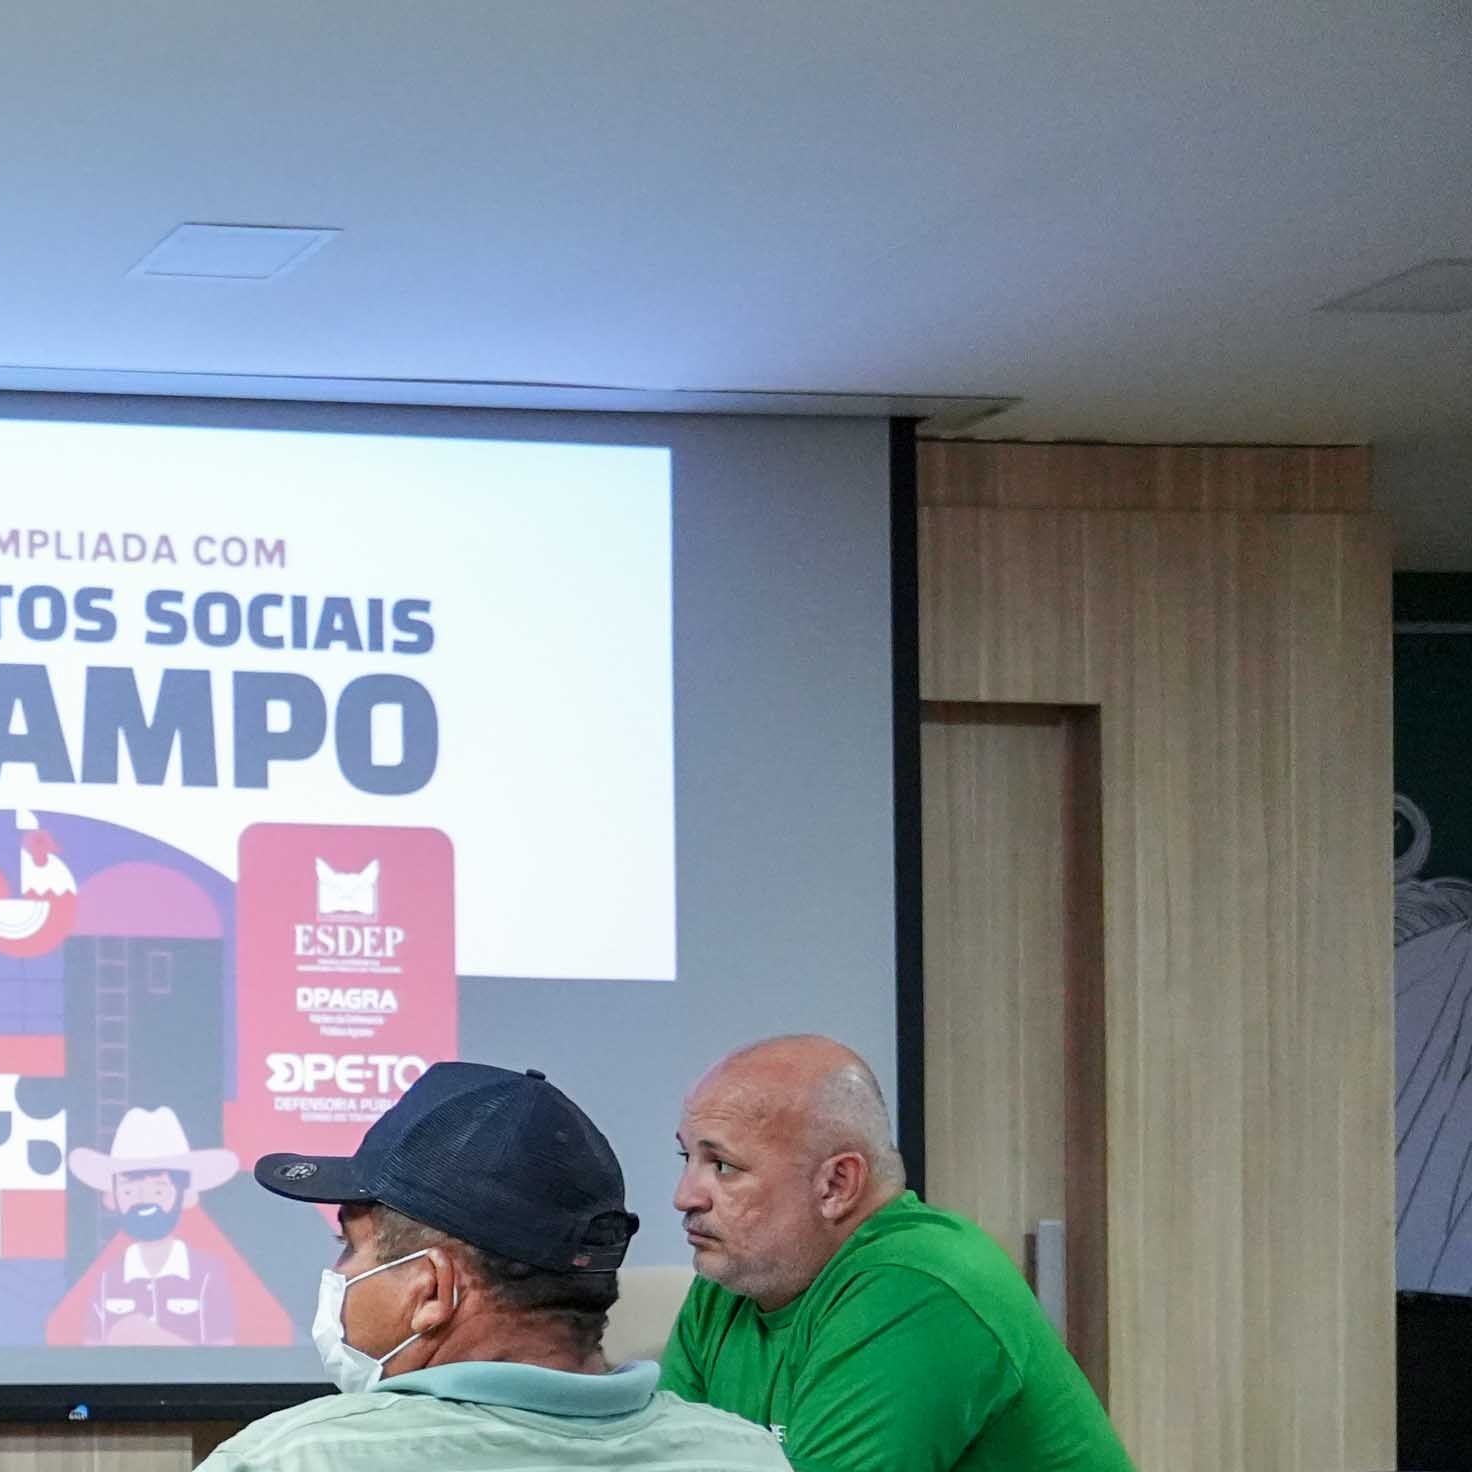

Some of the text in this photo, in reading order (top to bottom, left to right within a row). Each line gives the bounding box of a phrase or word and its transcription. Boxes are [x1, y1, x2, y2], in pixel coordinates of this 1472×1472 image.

[192, 534, 286, 569] COM
[143, 588, 437, 657] SOCIAIS
[294, 924, 405, 958] ESDEP
[296, 987, 398, 1010] DPAGRA
